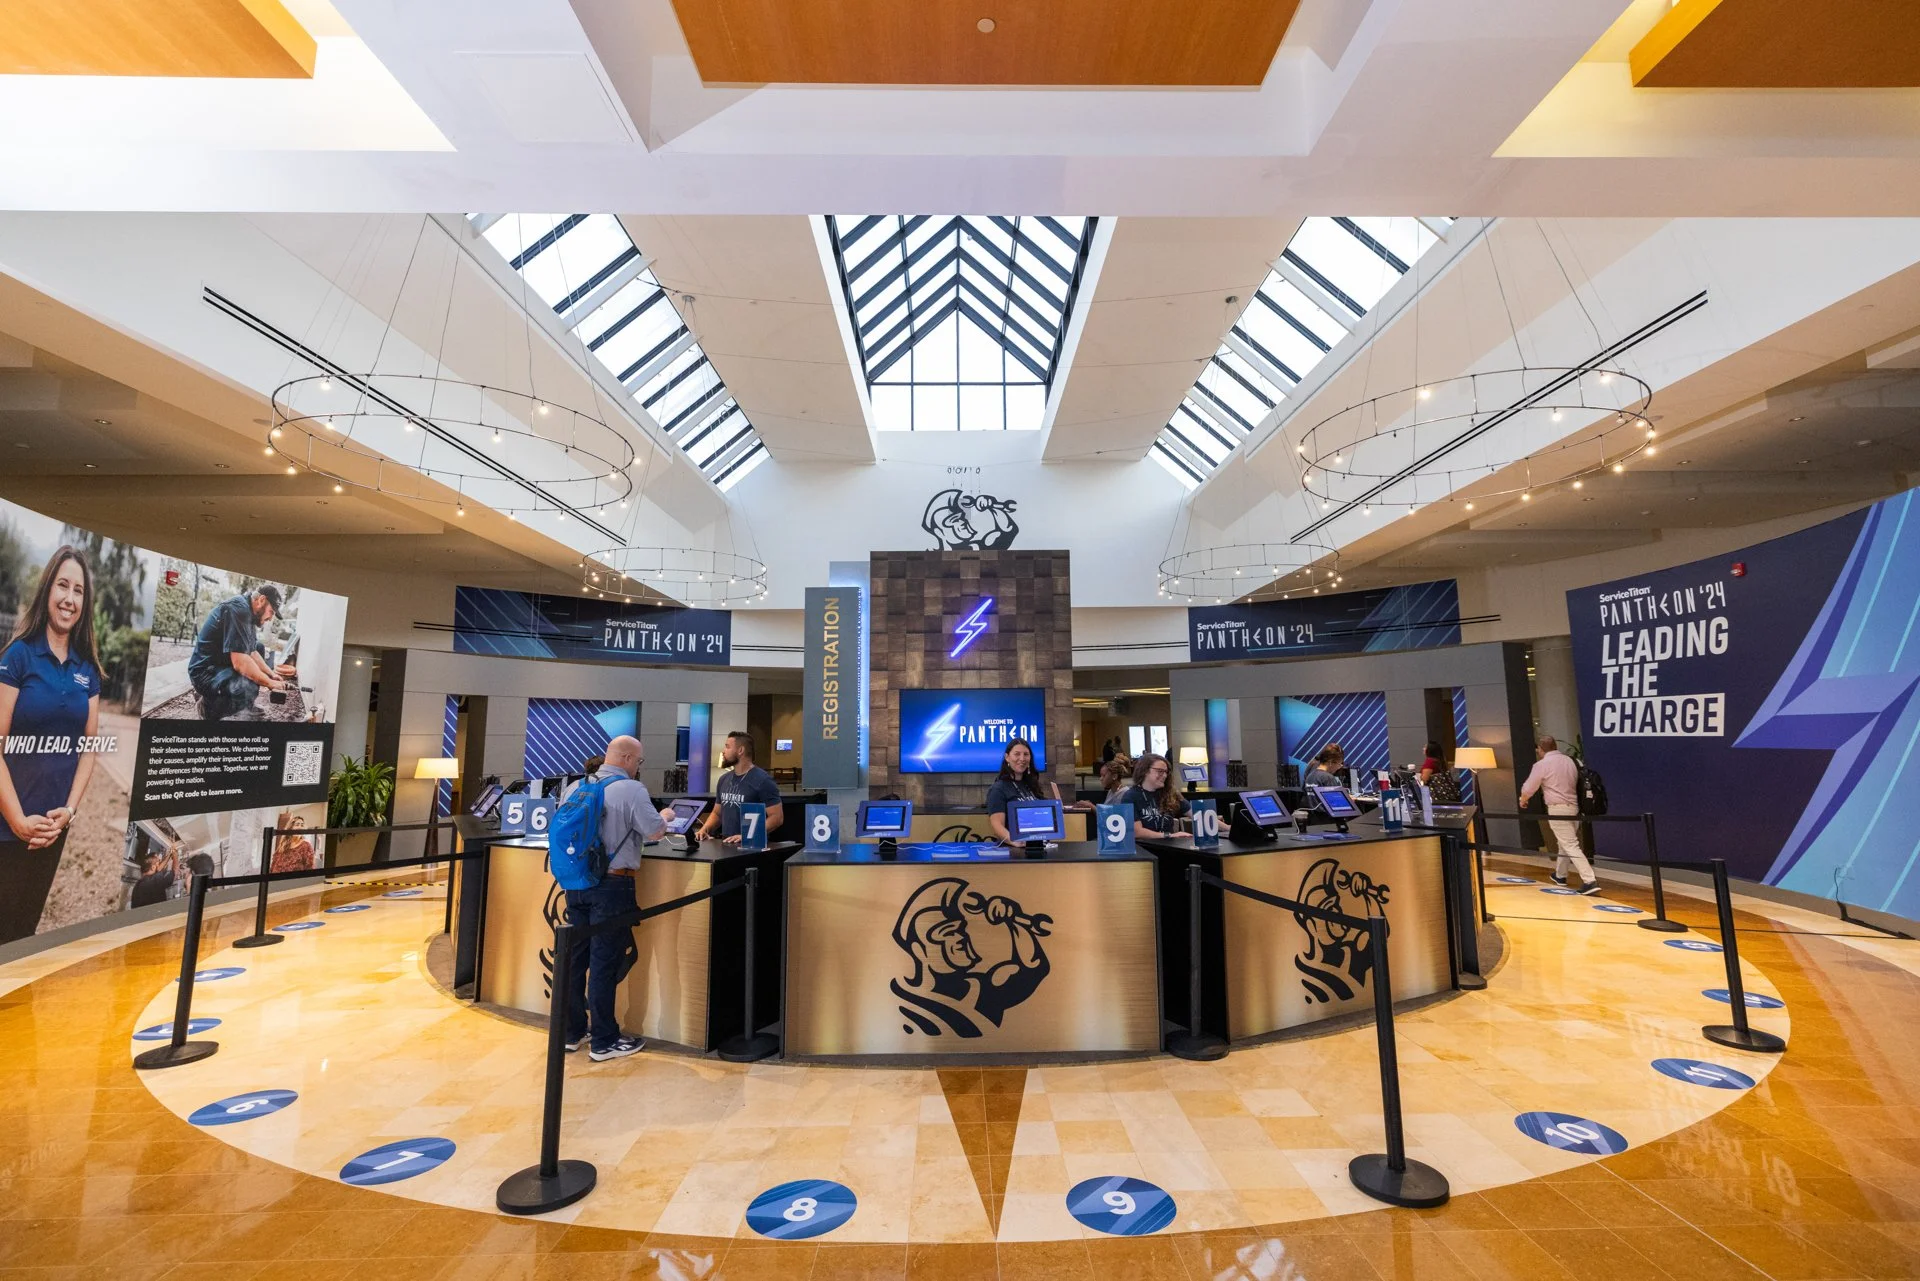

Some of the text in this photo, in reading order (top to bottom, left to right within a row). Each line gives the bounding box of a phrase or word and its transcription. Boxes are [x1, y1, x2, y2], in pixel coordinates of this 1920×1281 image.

[1600, 586, 1651, 603] ServiceTitan
[1601, 588, 1696, 627] PANTHEON
[606, 618, 658, 630] ServiceTitan
[1197, 621, 1246, 631] ServiceTitan
[604, 628, 697, 652] PANTHEON
[1197, 627, 1287, 650] PANTHEON
[1602, 616, 1729, 666] LEADING
[823, 597, 840, 740] REGISTRATION
[1601, 662, 1658, 698] THE
[1600, 697, 1719, 734] CHARGE
[4, 735, 36, 754] WHO
[37, 735, 72, 755] LEAD,
[76, 736, 118, 753] SERVE.
[959, 725, 1038, 743] PANTHEON
[146, 778, 174, 787] powering
[186, 776, 205, 784] nation.
[159, 767, 190, 775] differences
[223, 765, 248, 773] Together,
[145, 793, 160, 801] Scan
[173, 791, 184, 800] QR
[185, 790, 199, 798] code
[507, 802, 524, 825] 5
[531, 806, 548, 831] 6
[1385, 797, 1401, 822] 11
[744, 812, 761, 839] 7
[812, 814, 832, 842] 8
[1106, 814, 1127, 843] 9
[1193, 809, 1219, 838] 10
[1683, 1065, 1728, 1081] 11
[1544, 1122, 1600, 1145] 10
[373, 1150, 425, 1171] 7
[783, 1197, 818, 1222] 8
[1102, 1191, 1136, 1215] 9
